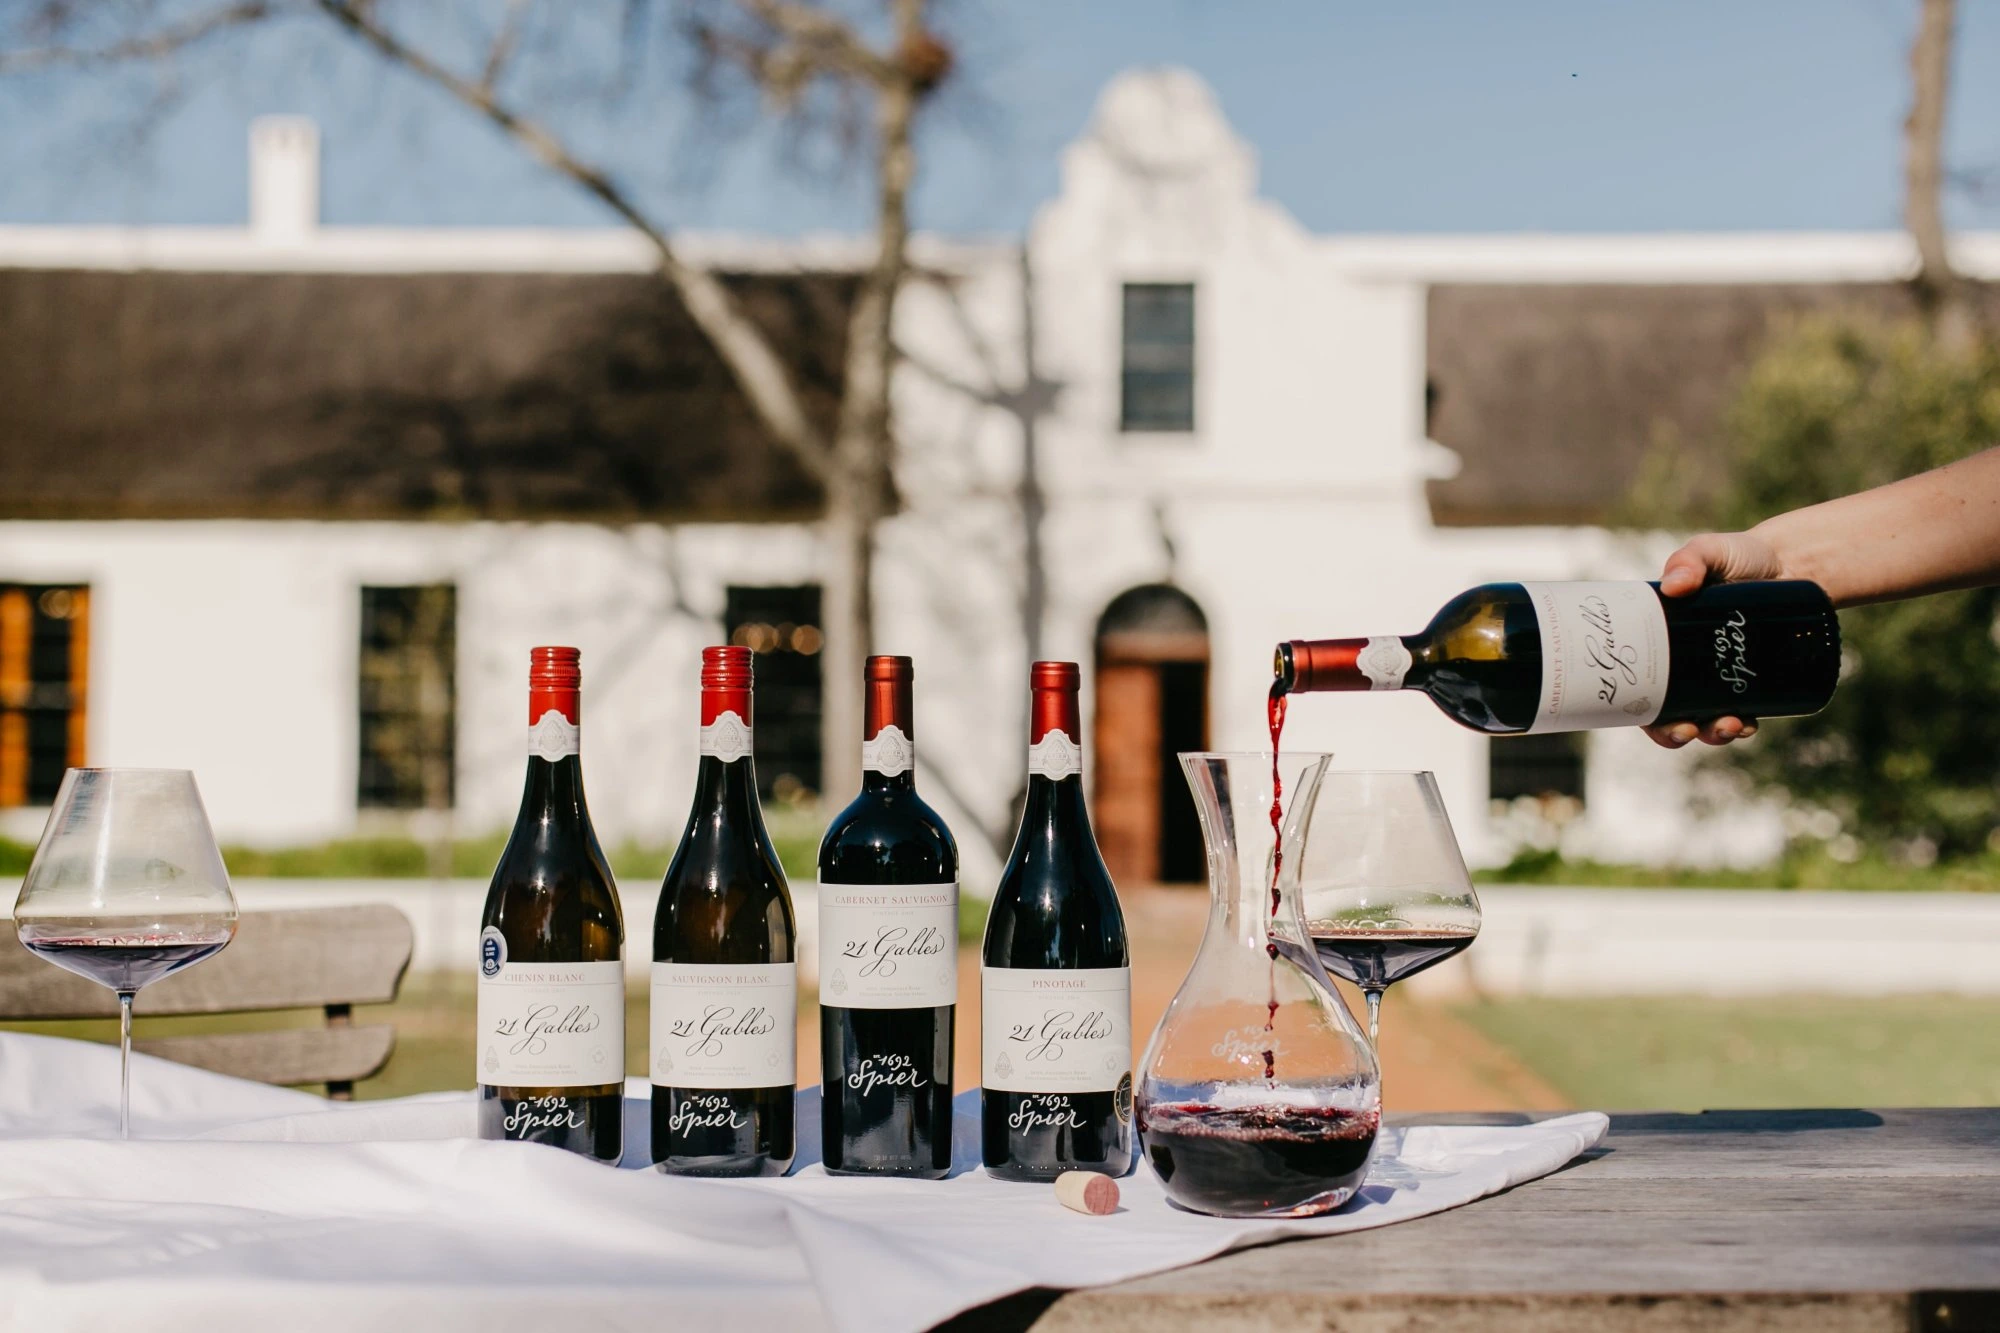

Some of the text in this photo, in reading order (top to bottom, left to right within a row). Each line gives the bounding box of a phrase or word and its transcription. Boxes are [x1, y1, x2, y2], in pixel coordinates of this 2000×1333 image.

[1543, 594, 1563, 714] CABERNET SAUVIGNON
[1579, 595, 1638, 705] 21 Gables
[1714, 626, 1731, 660] 1692
[1720, 610, 1757, 693] Spier
[834, 895, 949, 905] CABERNET SAUVIGNON
[841, 925, 945, 978] 21 Gables
[504, 973, 585, 983] CHENIN BLANC
[672, 975, 771, 984] SAUVIGNON BLANC
[1032, 979, 1087, 989] PINOTAGE
[493, 1002, 600, 1055] 21 Gables
[669, 1004, 775, 1057] 21 Gables
[1008, 1009, 1113, 1062] 21 Gables
[848, 1060, 928, 1097] Spier
[878, 1053, 912, 1071] 1692
[503, 1101, 585, 1139] Spier
[533, 1095, 569, 1112] 1692
[669, 1101, 748, 1139] Spier
[697, 1095, 731, 1113] 1692
[1008, 1099, 1087, 1137] Spier
[1037, 1094, 1071, 1111] 1692
